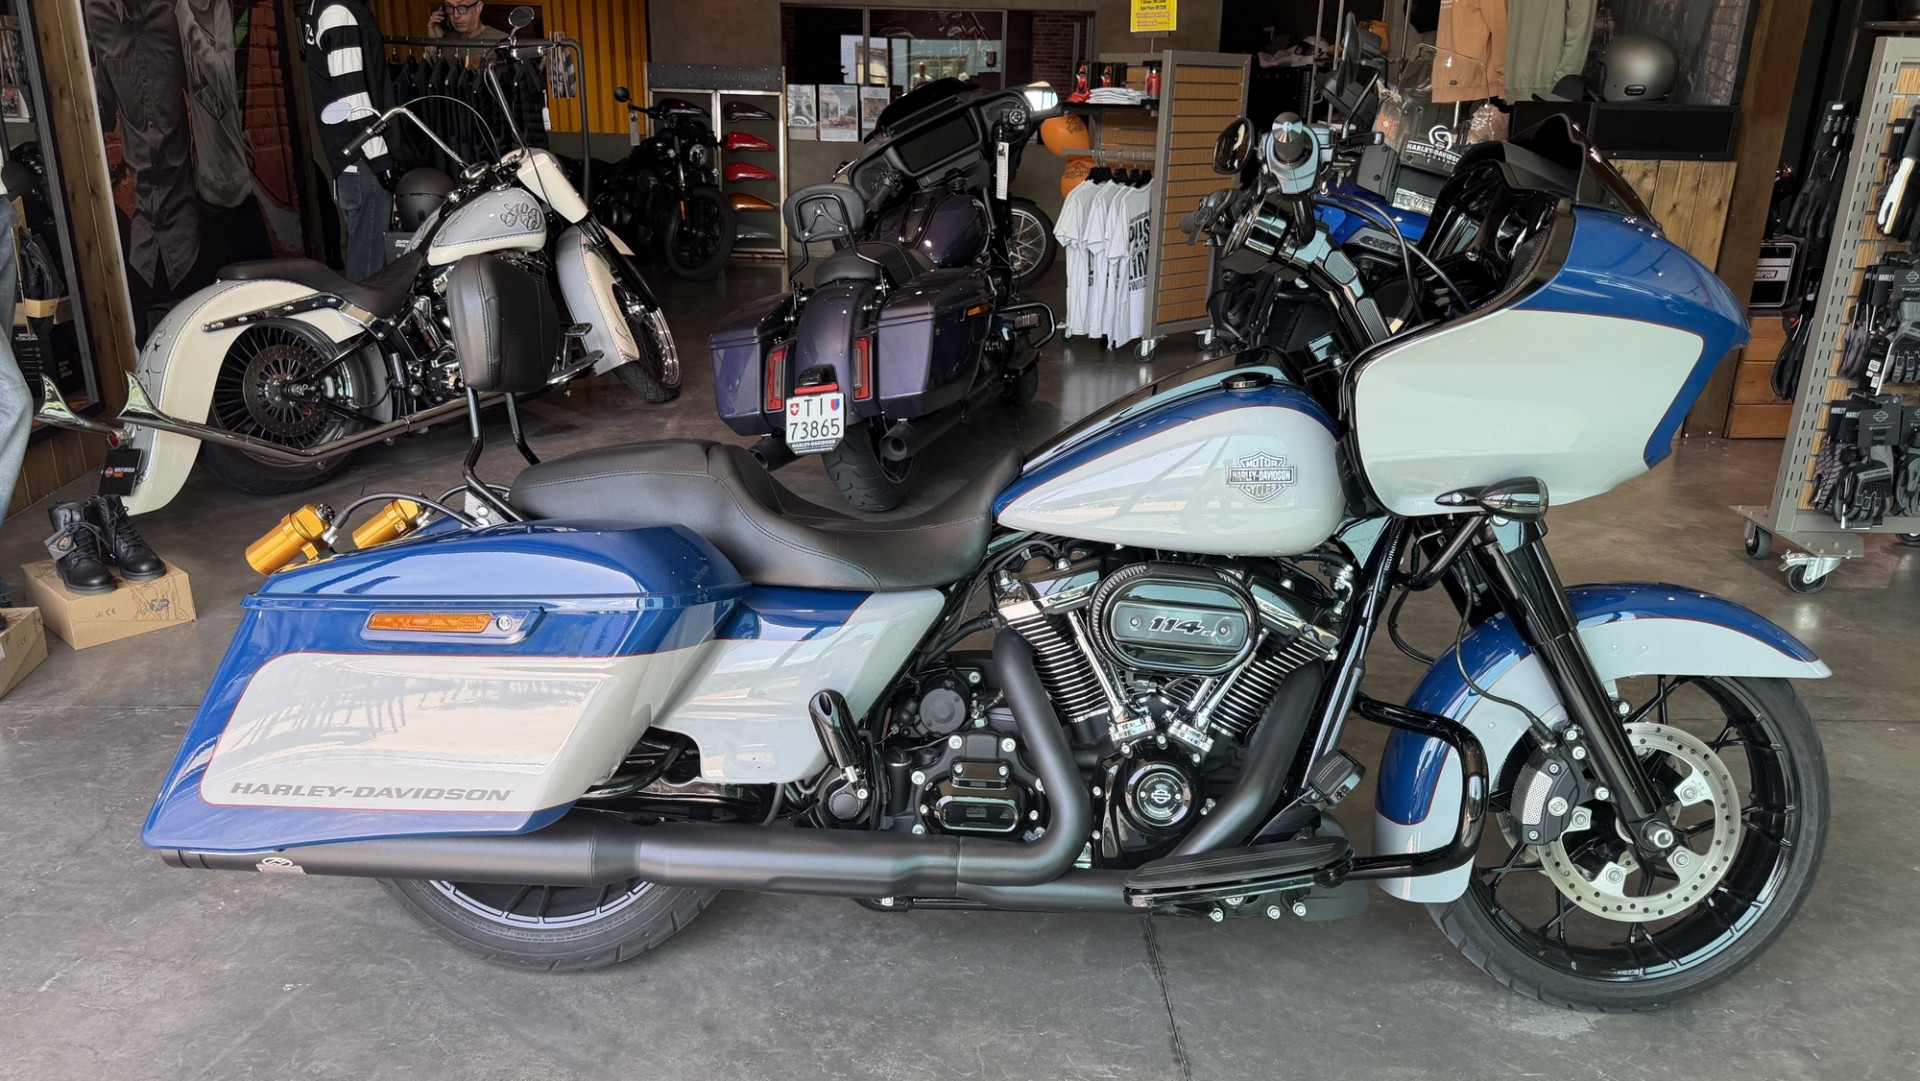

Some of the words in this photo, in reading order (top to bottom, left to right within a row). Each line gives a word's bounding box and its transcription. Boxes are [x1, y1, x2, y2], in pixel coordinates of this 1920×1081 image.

[804, 398, 823, 417] TI
[789, 418, 840, 441] 73865
[1245, 455, 1278, 468] MOTOR
[1231, 469, 1292, 482] HARLEY-DAVIDSON
[1245, 484, 1277, 497] CYCLES
[1148, 616, 1205, 635] 114
[230, 782, 513, 802] HARLEY-DAVIDSON
